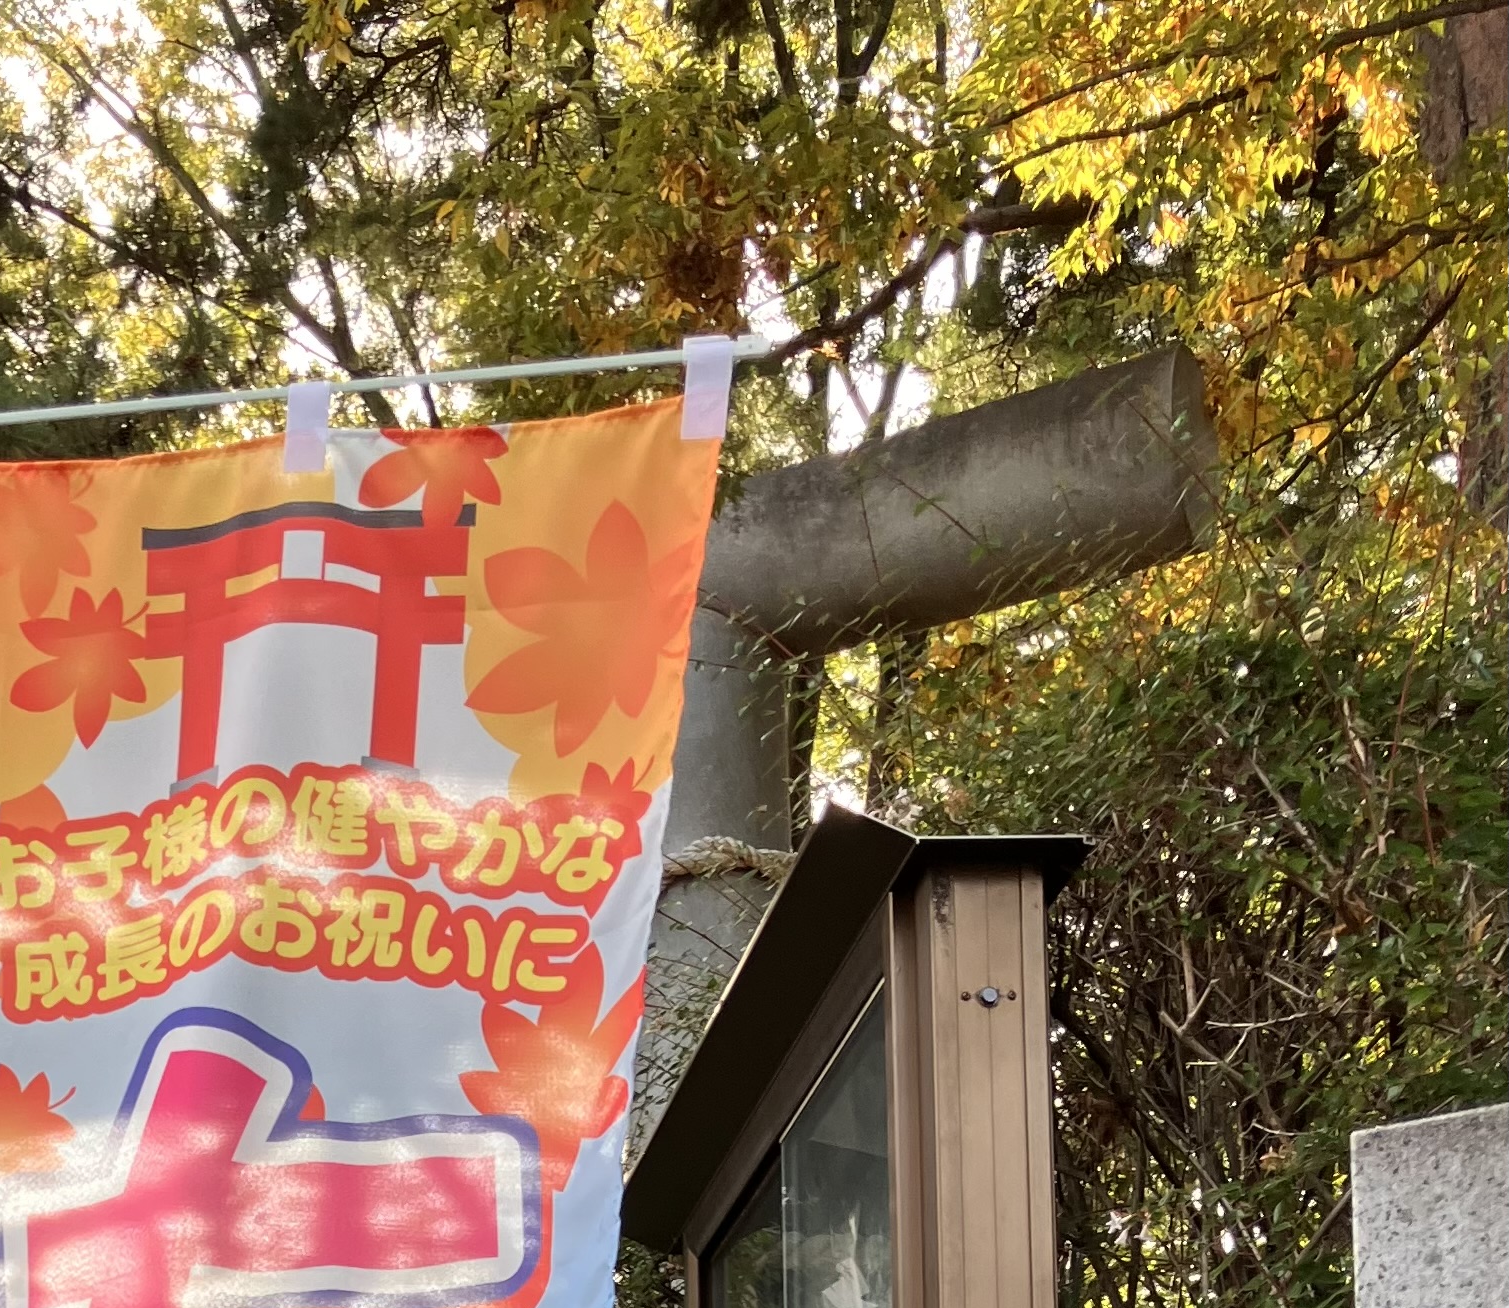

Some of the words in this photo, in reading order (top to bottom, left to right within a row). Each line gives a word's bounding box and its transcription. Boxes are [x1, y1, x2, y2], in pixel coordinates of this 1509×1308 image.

[13, 878, 578, 1011] 成長のお祝いに
